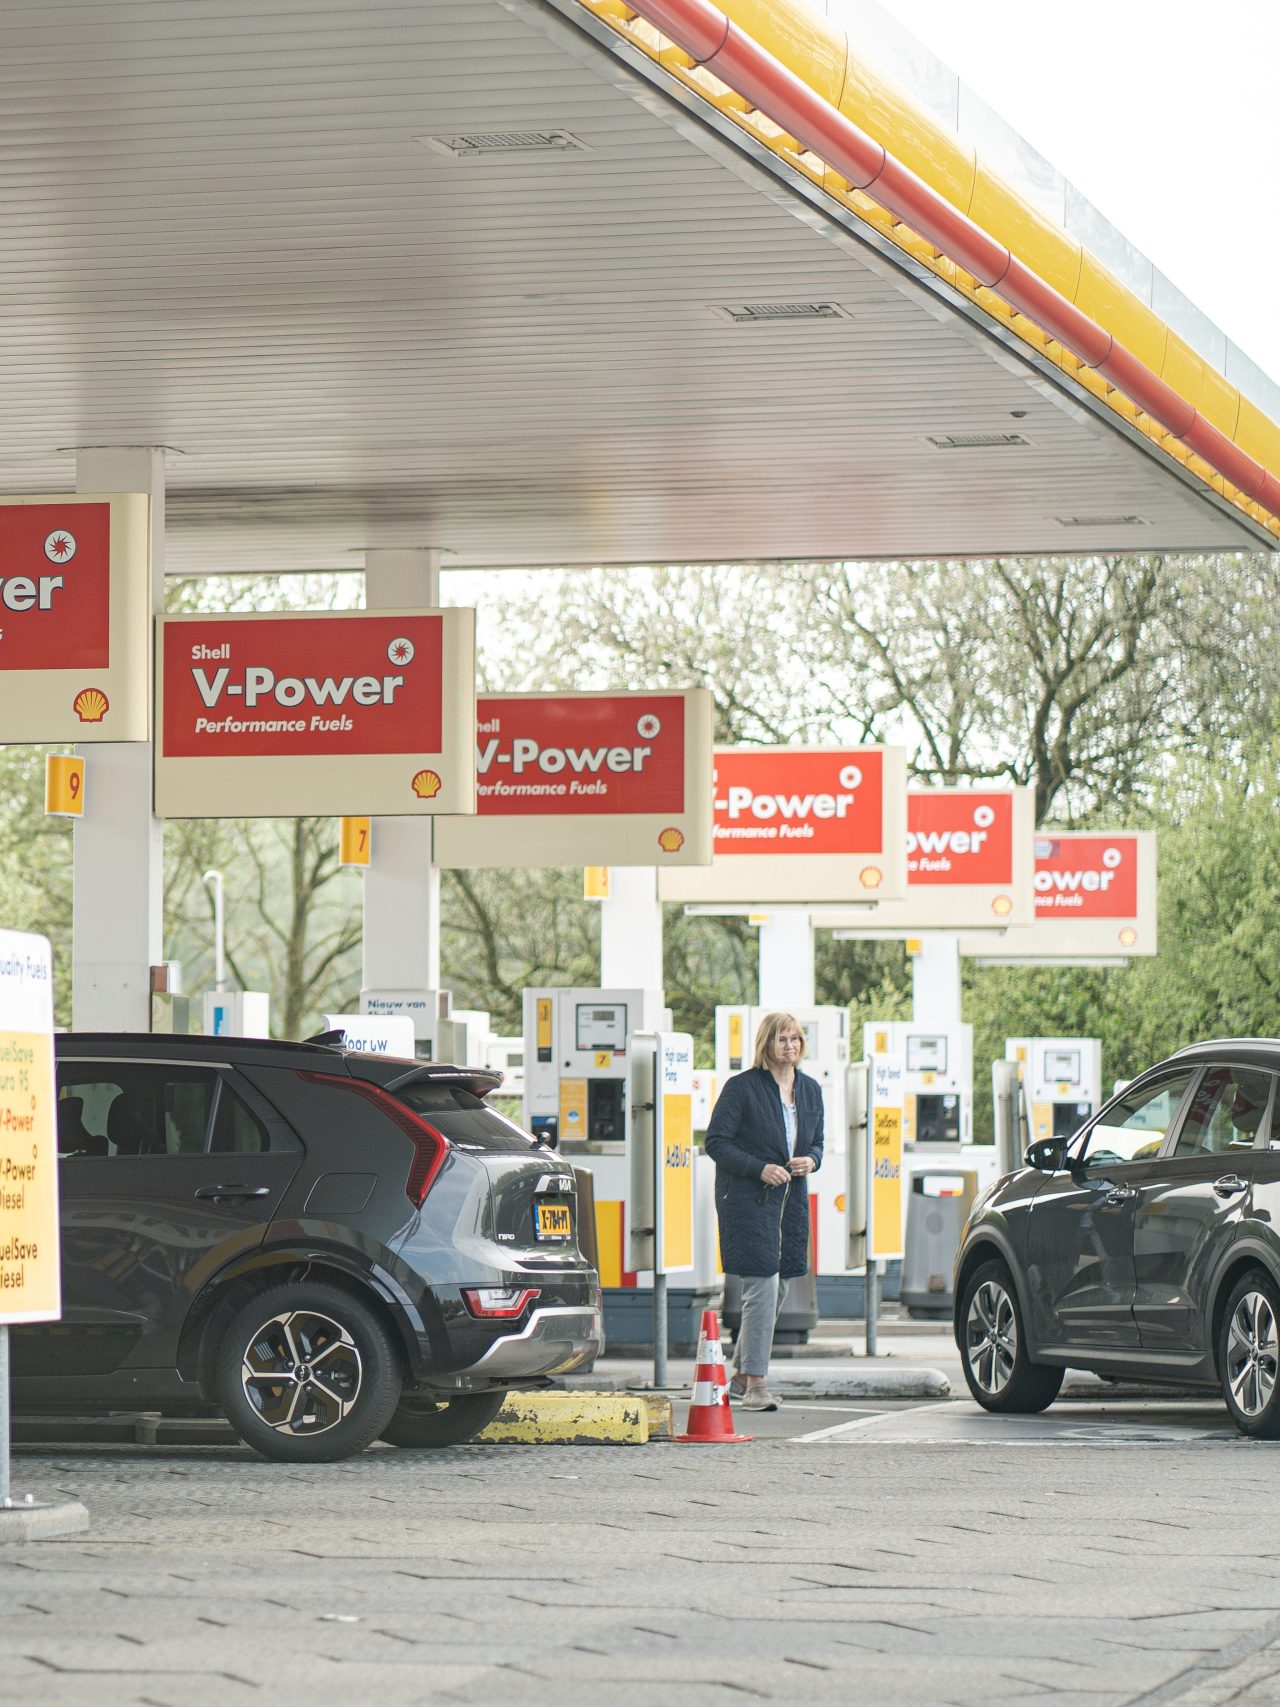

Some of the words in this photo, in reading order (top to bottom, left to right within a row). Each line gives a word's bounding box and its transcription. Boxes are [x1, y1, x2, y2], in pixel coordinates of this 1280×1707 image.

[191, 643, 230, 659] Shell
[191, 666, 404, 708] V-Power
[195, 716, 306, 733] Performance
[310, 714, 353, 731] Fuels
[477, 718, 500, 733] hell
[476, 738, 651, 773] V-Power
[69, 772, 80, 800] 9
[569, 780, 608, 795] Fuels
[358, 829, 367, 852] 7
[712, 824, 777, 839] formance
[779, 823, 815, 838] Fuels
[905, 830, 987, 854] ower
[1033, 870, 1115, 892] ower
[26, 955, 47, 980] Fuels
[368, 1000, 402, 1009] Nieuw
[405, 1001, 426, 1009] van
[20, 1068, 29, 1092] 95
